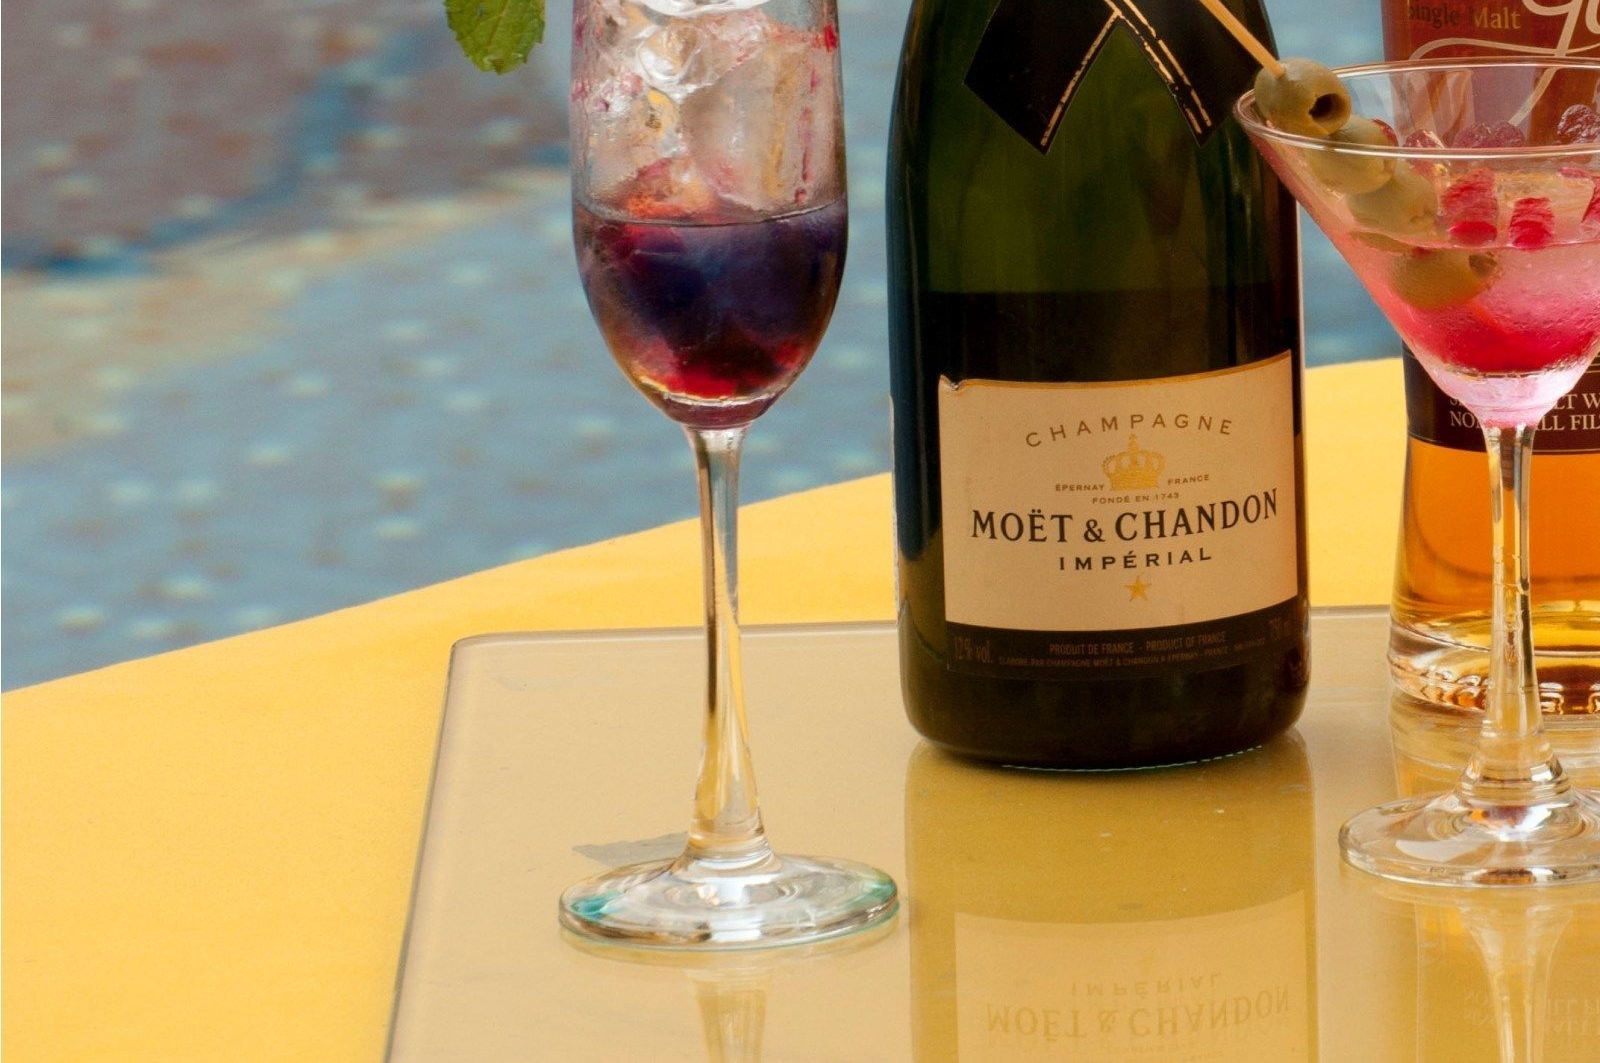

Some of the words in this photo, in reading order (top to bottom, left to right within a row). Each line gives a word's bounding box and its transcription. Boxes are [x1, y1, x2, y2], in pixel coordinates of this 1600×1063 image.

[1470, 6, 1521, 30] Malt
[1026, 413, 1232, 448] CHAMPAGNE
[1167, 474, 1210, 487] FRANCE
[1135, 494, 1150, 503] EN
[1154, 491, 1180, 501] 1743
[971, 508, 1073, 543] MOËT
[1083, 519, 1106, 543] &
[1114, 488, 1278, 541] CHANDON
[1059, 546, 1212, 571] IMPÉRIAL
[1050, 642, 1085, 655] PRODUIT
[1088, 642, 1100, 655] DE
[1102, 641, 1134, 655] FRANCE
